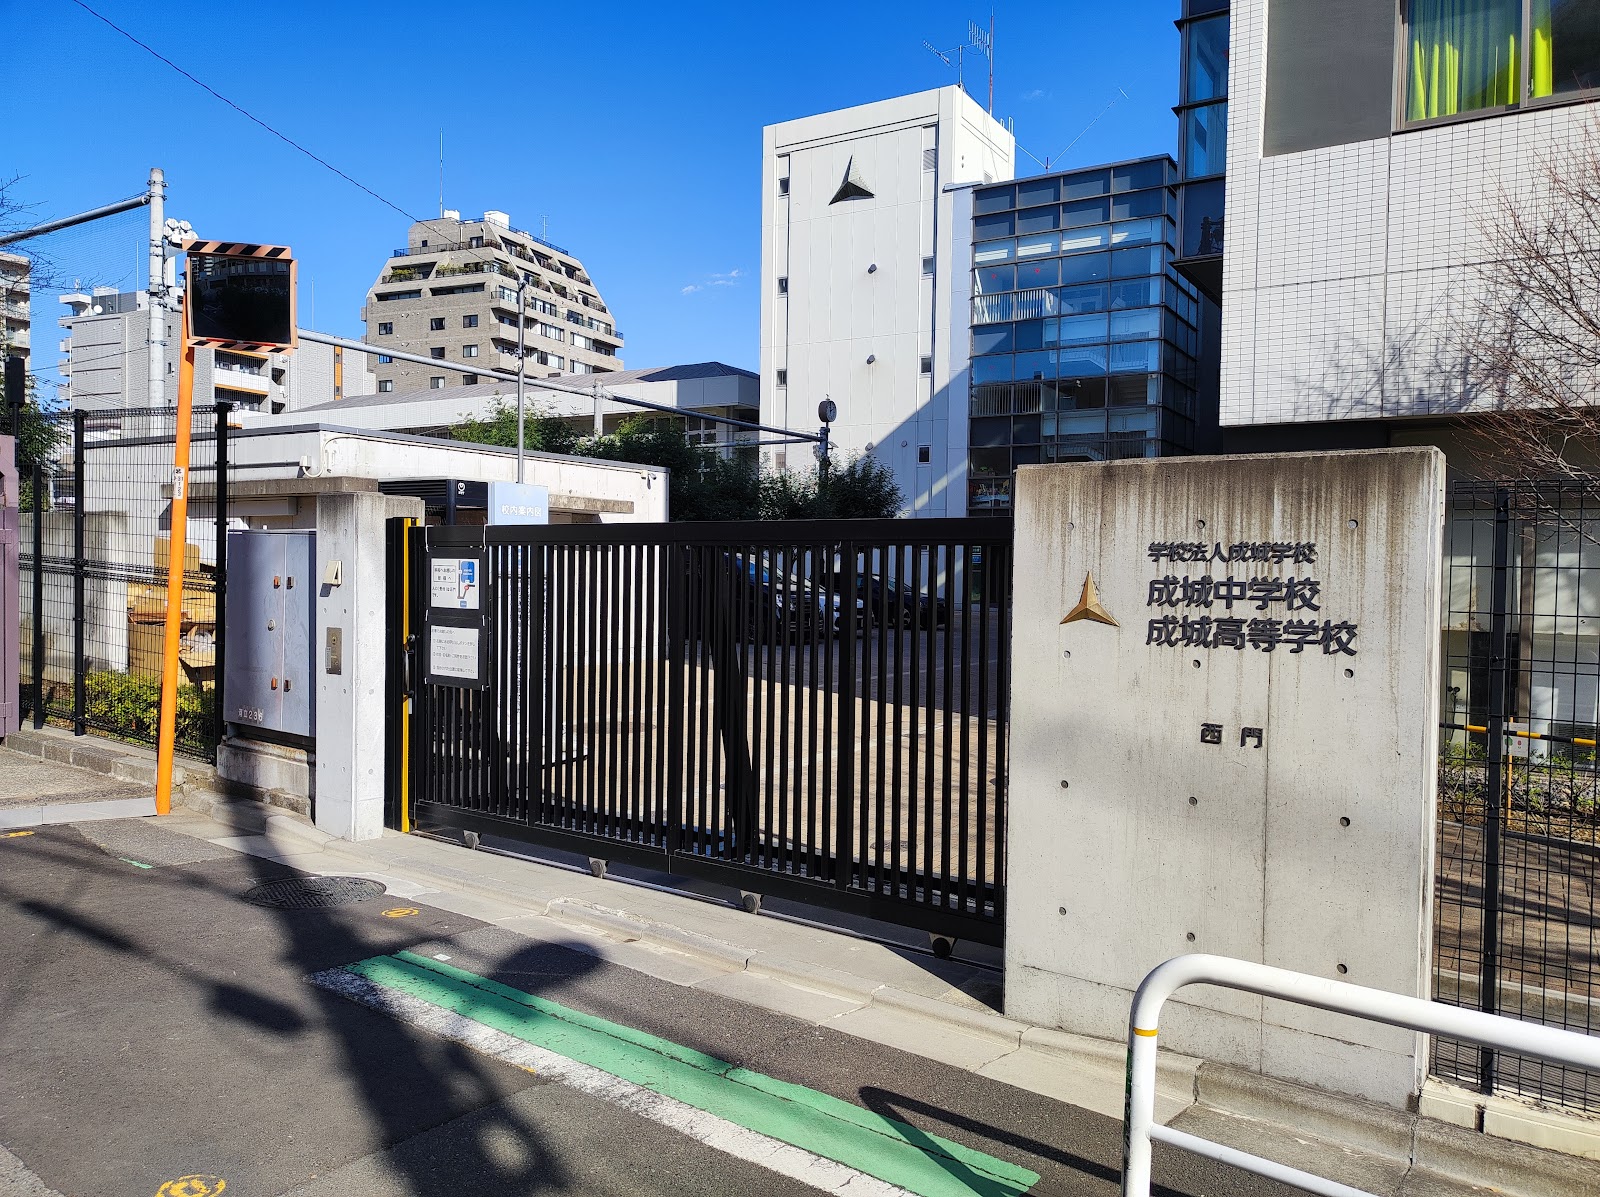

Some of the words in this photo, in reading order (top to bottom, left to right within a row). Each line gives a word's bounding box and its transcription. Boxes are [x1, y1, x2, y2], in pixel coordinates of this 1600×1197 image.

[1147, 541, 1318, 564] 学校法人成城学校
[1146, 575, 1321, 611] 成城中学校
[1145, 614, 1358, 657] 成城高等学校
